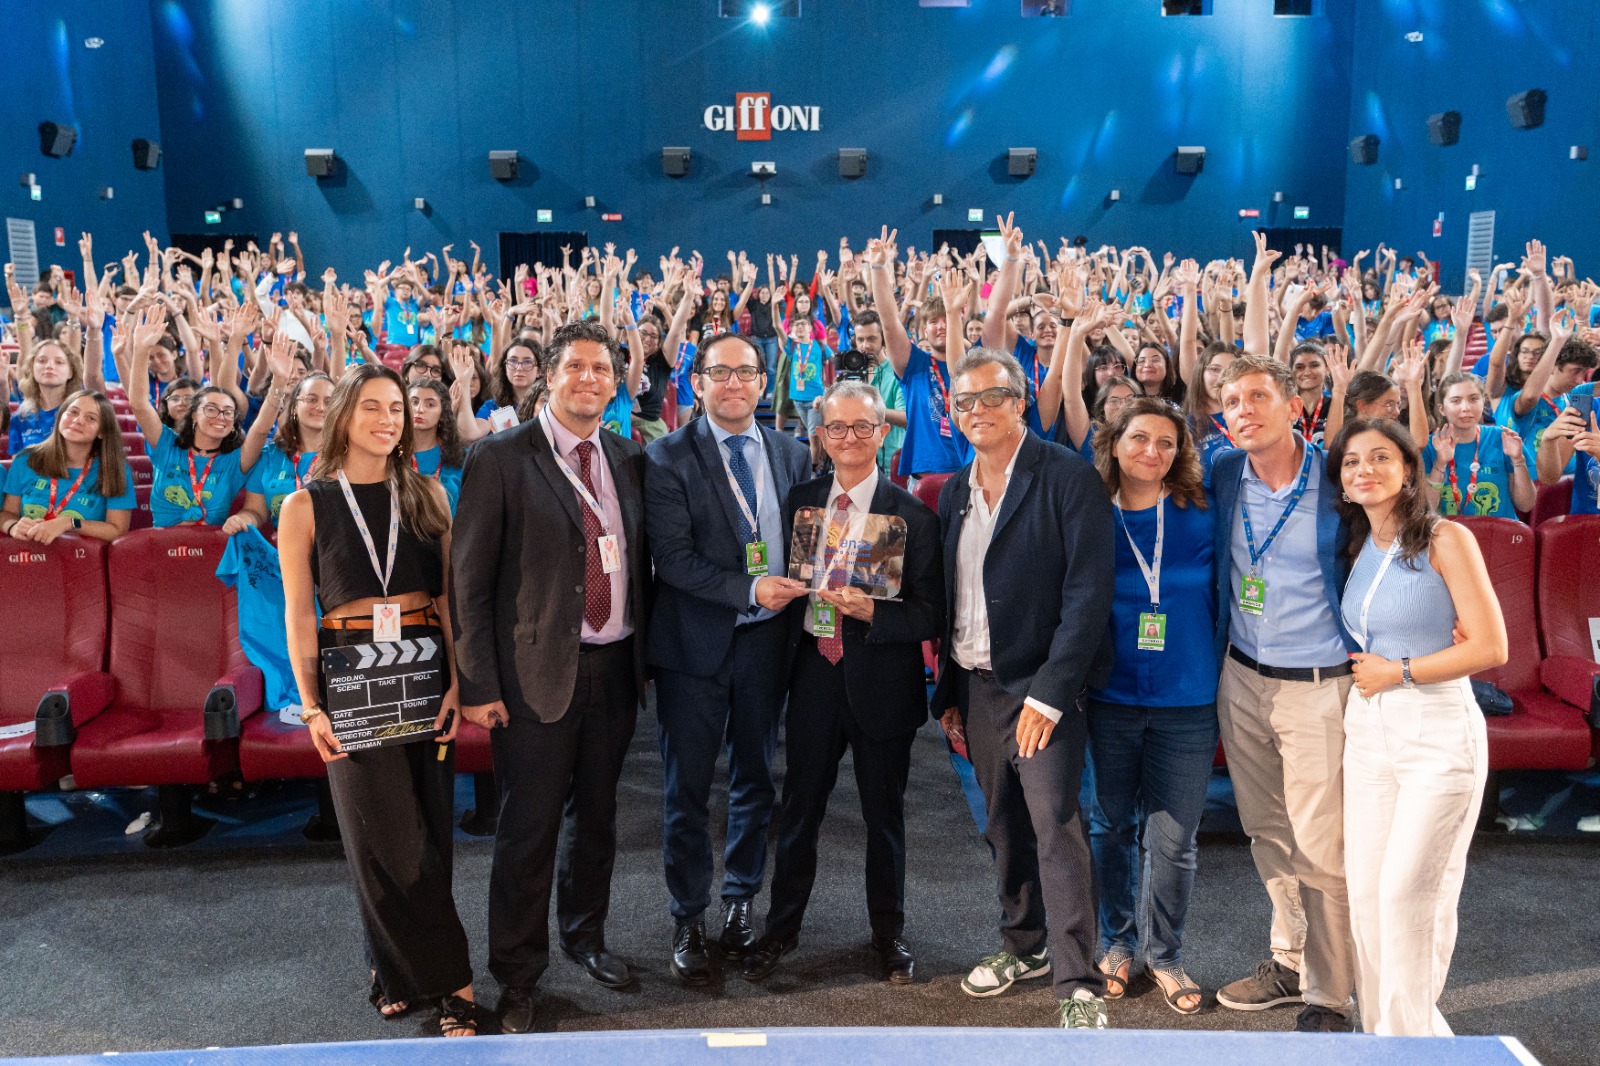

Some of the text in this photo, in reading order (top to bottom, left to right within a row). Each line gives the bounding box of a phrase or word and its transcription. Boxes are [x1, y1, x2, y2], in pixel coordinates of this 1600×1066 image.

[1511, 535, 1523, 544] 19
[841, 539, 872, 551] anas
[75, 548, 86, 559] 12
[413, 673, 431, 681] ROLL
[336, 684, 361, 693] SCENE
[403, 699, 427, 708] SOUND
[336, 730, 372, 741] DIRECTOR
[337, 741, 381, 752] AMERAMAN
